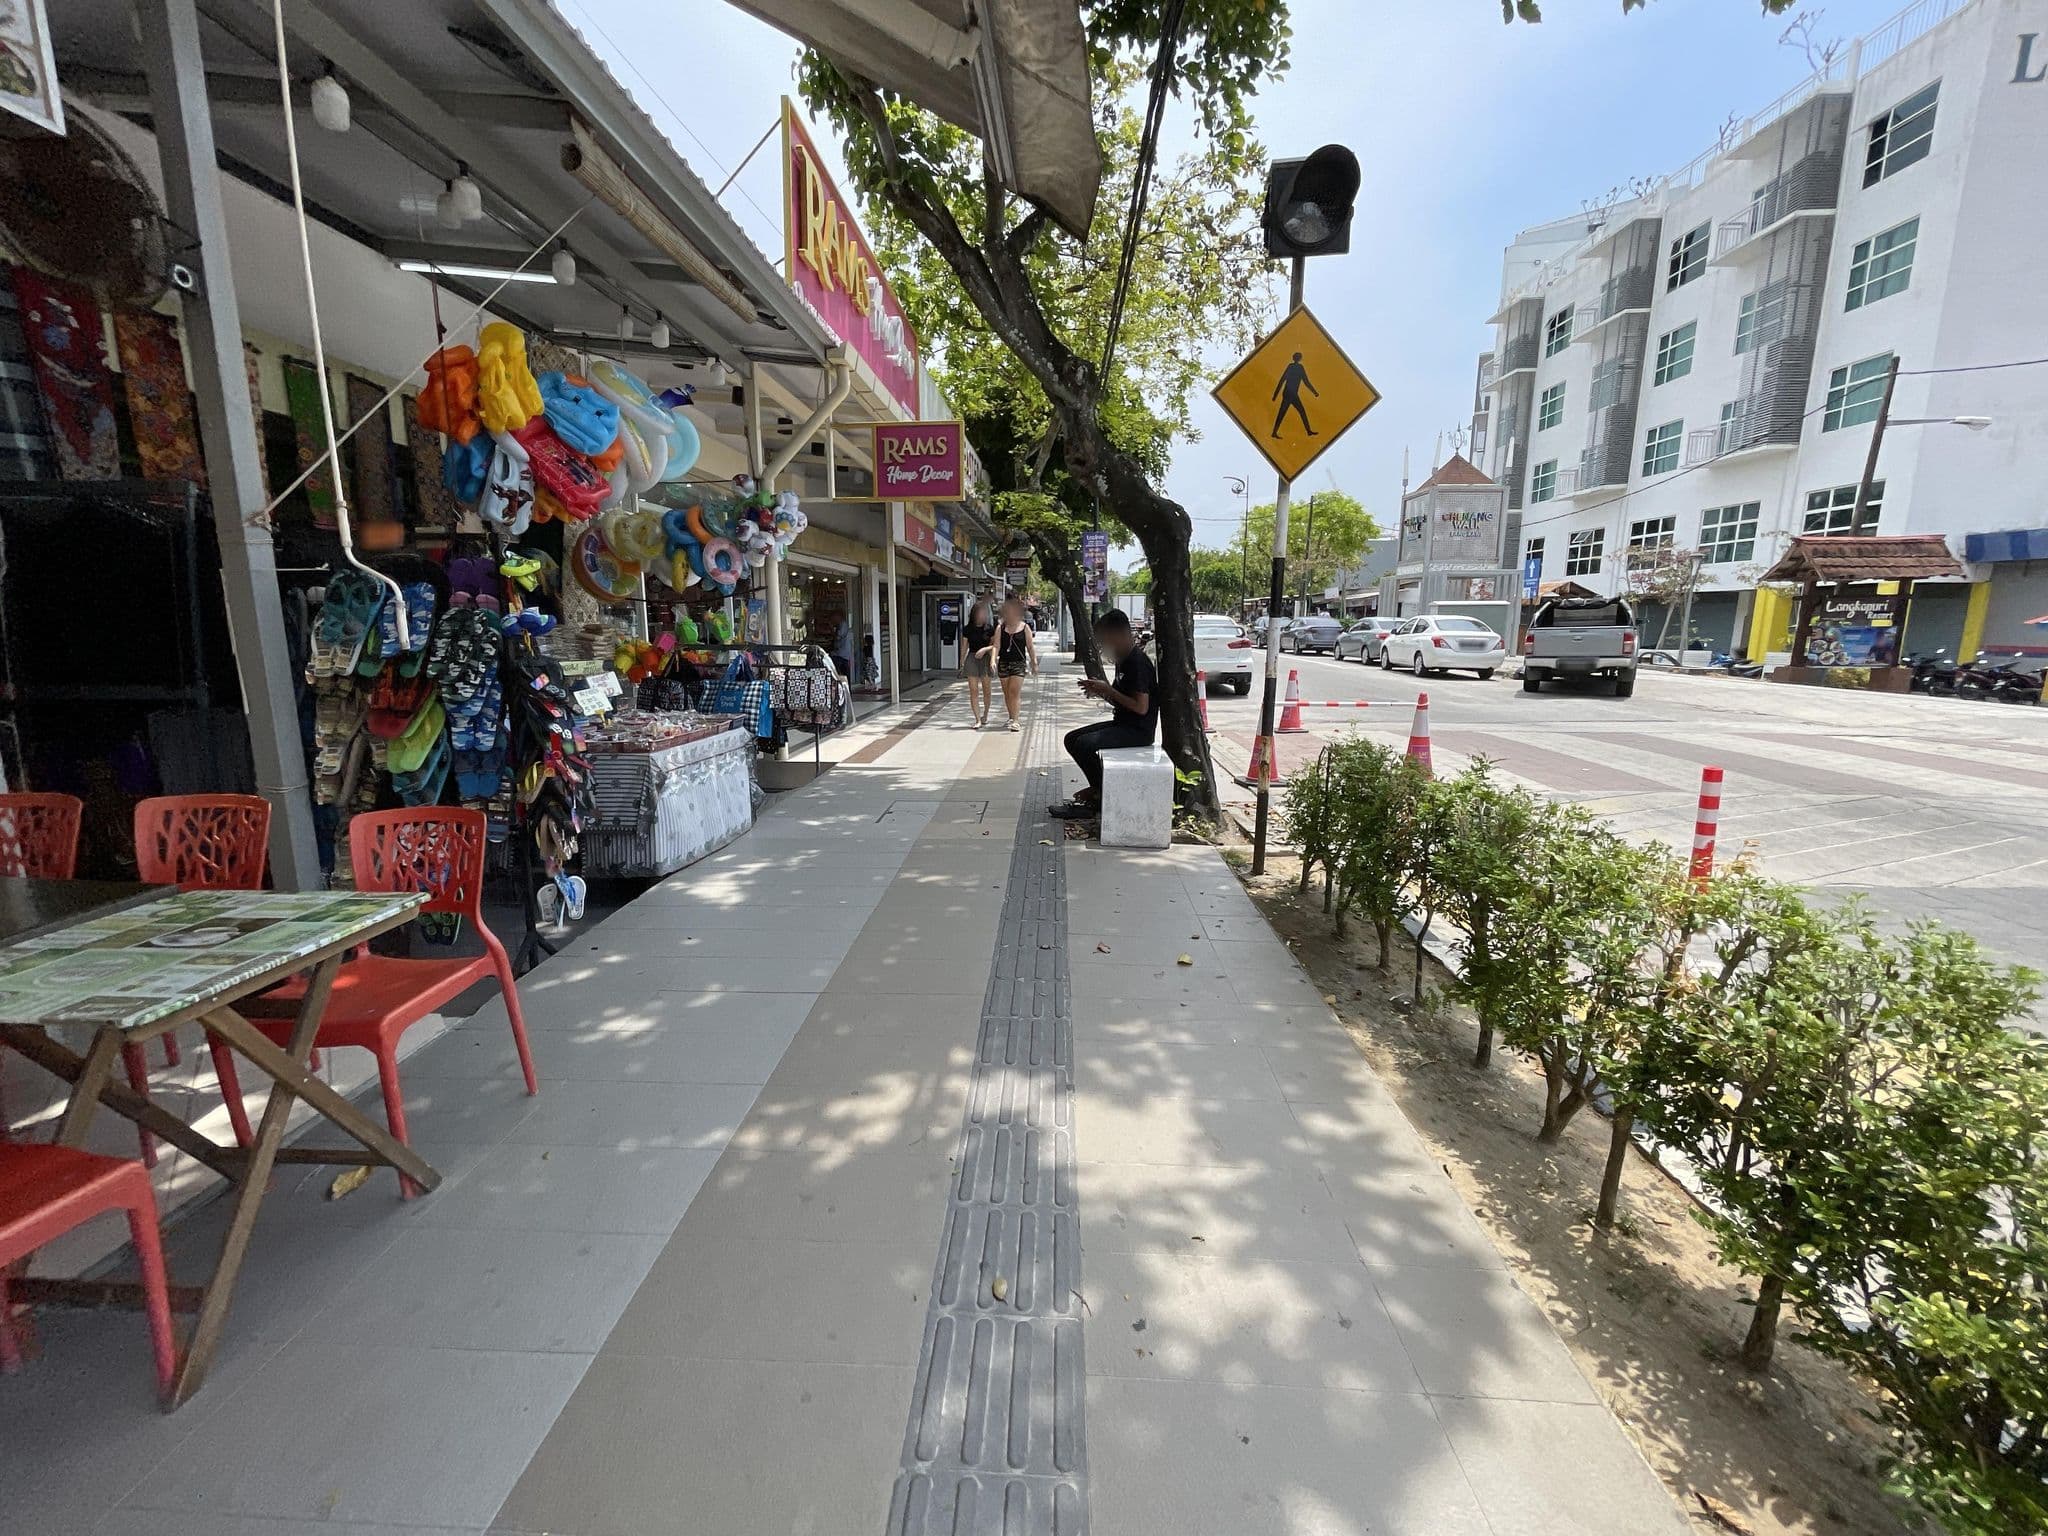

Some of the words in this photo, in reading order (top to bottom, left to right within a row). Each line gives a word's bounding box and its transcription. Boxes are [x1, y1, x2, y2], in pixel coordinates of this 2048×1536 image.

[795, 144, 871, 318] RAMS
[881, 436, 948, 464] RAMS
[886, 465, 918, 485] Home
[919, 464, 954, 484] Decor
[1826, 600, 1889, 618] Langkapuri
